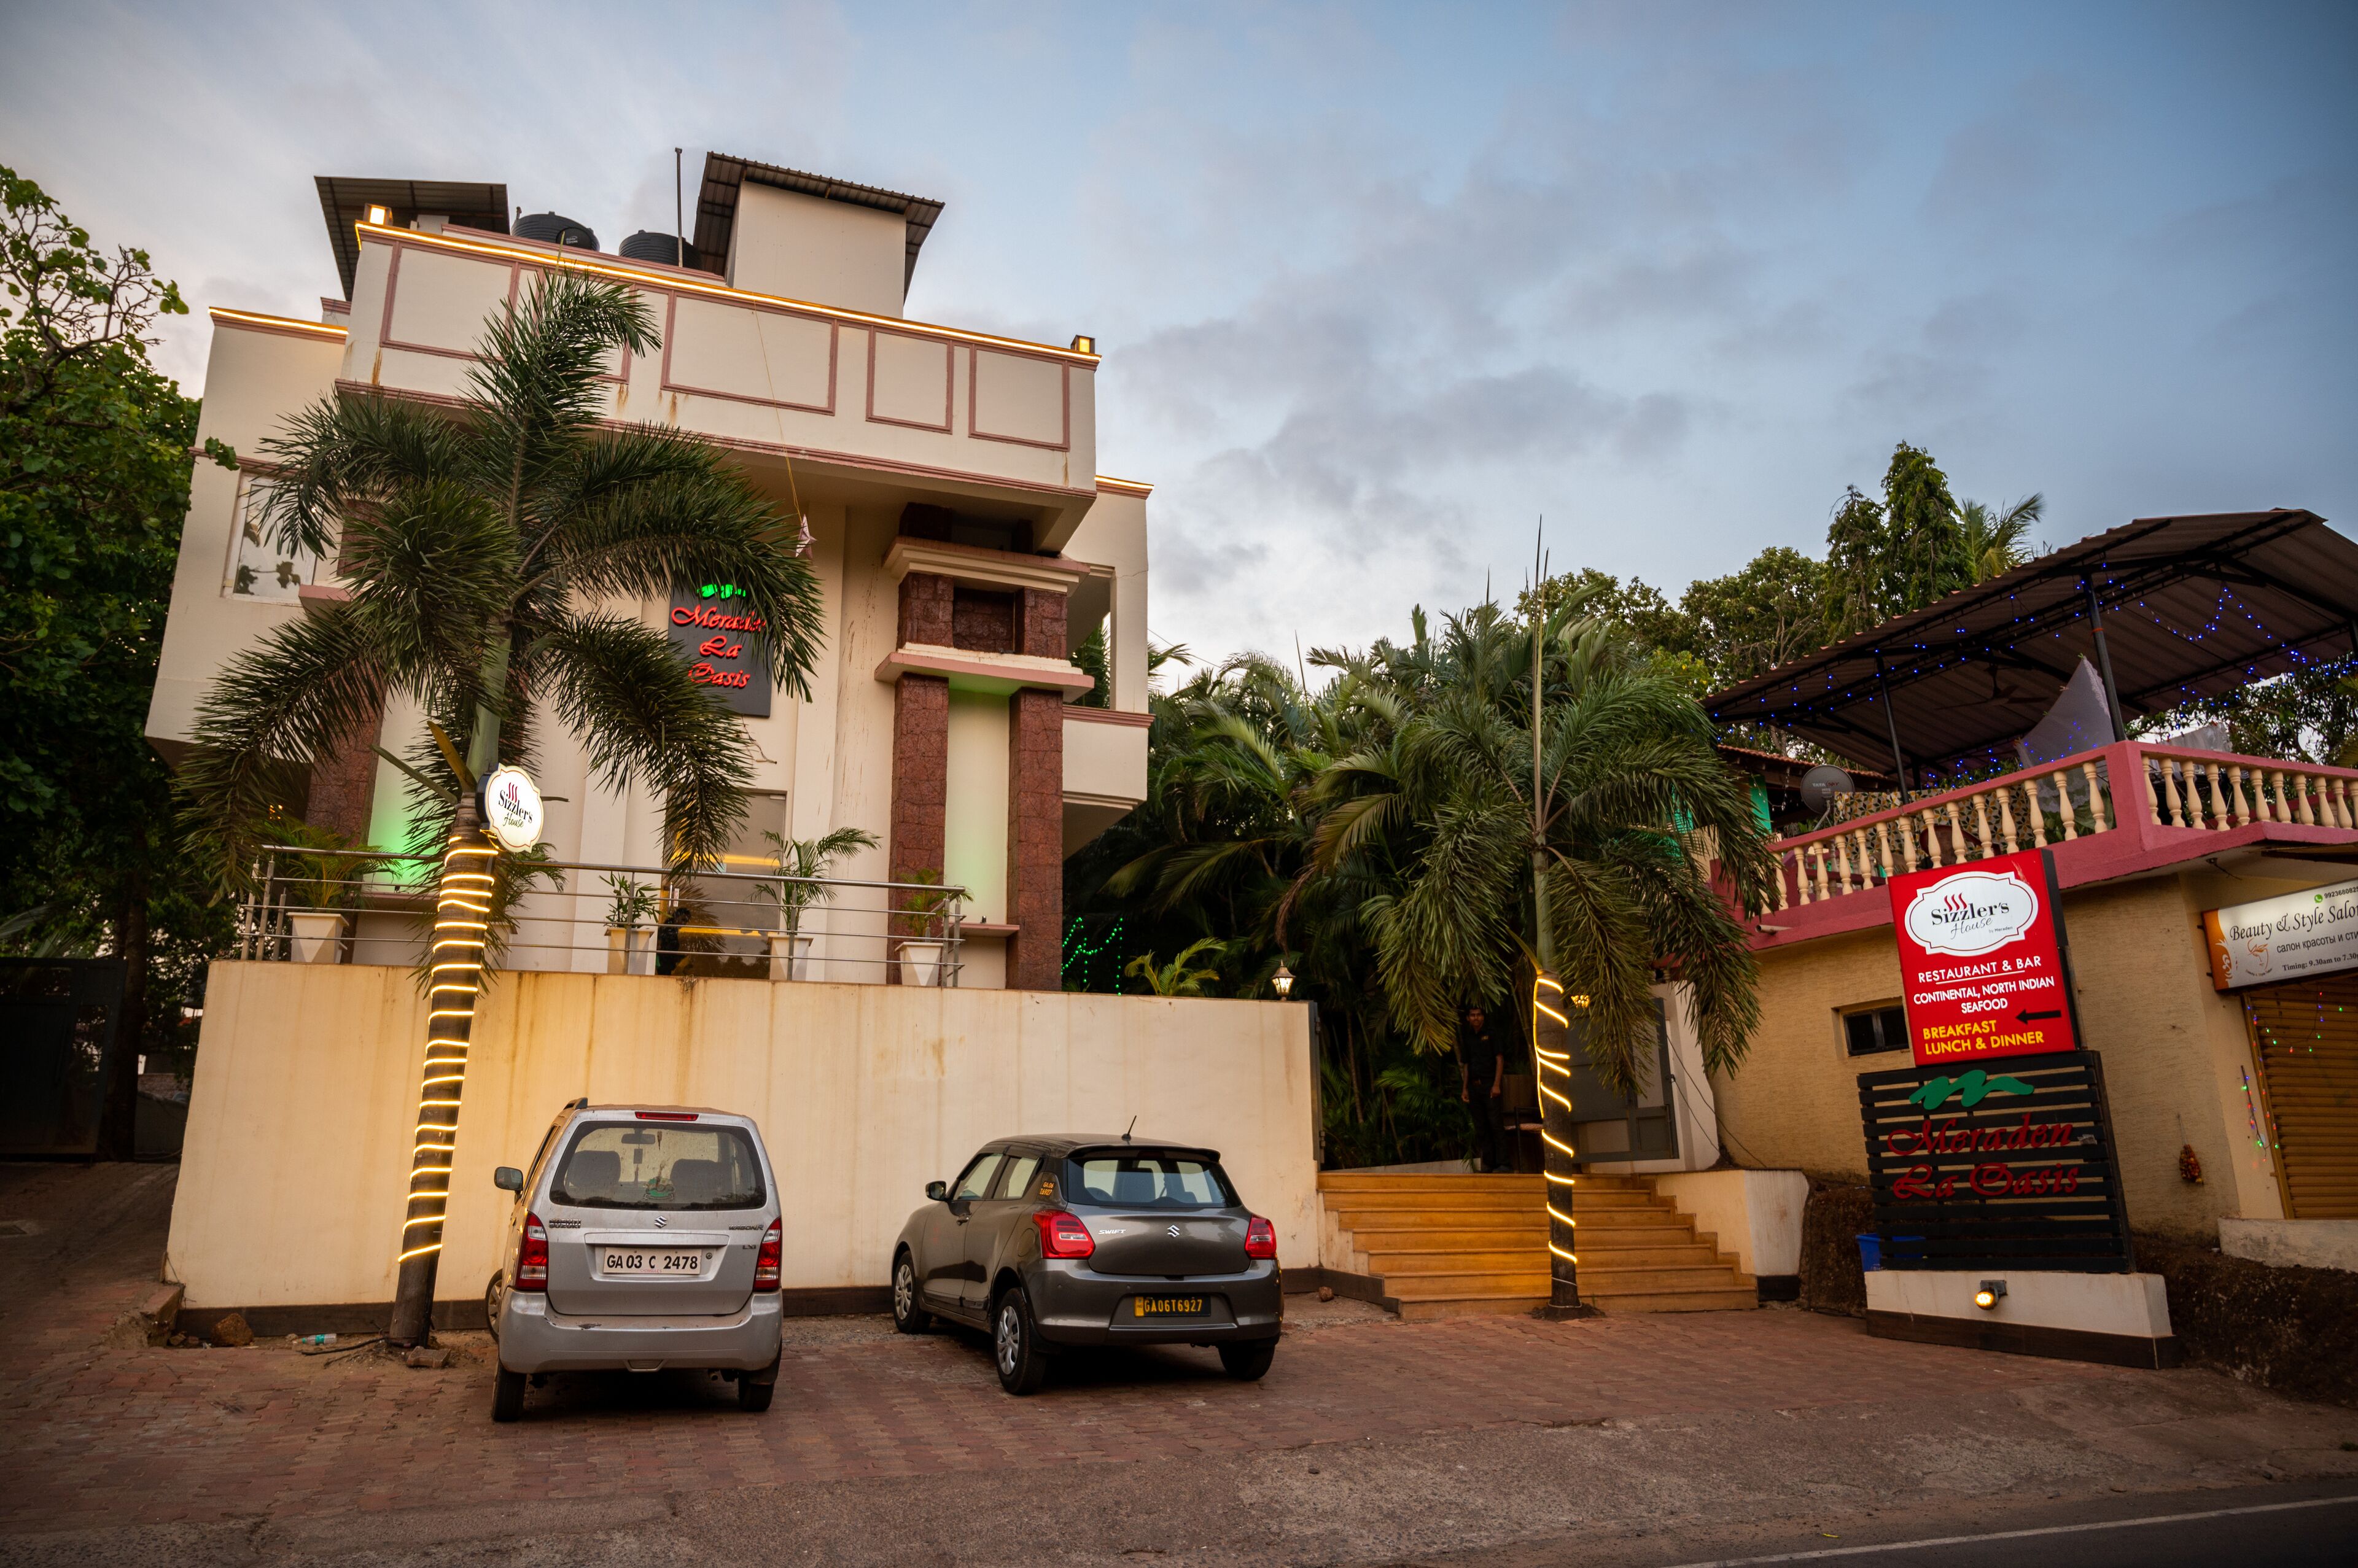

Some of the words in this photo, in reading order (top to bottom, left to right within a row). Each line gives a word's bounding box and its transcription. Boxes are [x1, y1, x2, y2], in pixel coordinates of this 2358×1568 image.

[699, 635, 742, 658] La
[688, 662, 751, 688] Oasis
[498, 790, 532, 823] Sizzler's
[503, 812, 524, 828] House
[1931, 902, 2009, 925] Sizzler's
[2230, 922, 2272, 941] Beauty
[2276, 914, 2290, 932] &
[2293, 907, 2324, 932] Style
[1950, 917, 1993, 940] House
[2276, 942, 2301, 953] салон
[2302, 936, 2336, 950] красоты
[1918, 962, 1997, 983] RESTAURANT
[2002, 960, 2012, 971] &
[2016, 956, 2041, 969] BAR
[2282, 961, 2308, 971] Timing:
[2309, 957, 2333, 967] 9.30am
[1913, 987, 1980, 1004] CONTINENTAL,
[1982, 981, 2017, 996] NORTH
[2019, 976, 2055, 990] INDIAN
[1961, 998, 2008, 1014] SEAFOOD
[1923, 1020, 1997, 1040] BREAKFAST
[1925, 1039, 1971, 1055] LUNCH
[1975, 1038, 1986, 1049] &
[1990, 1031, 2044, 1048] DINNER
[1888, 1112, 2073, 1155] Meraden
[1893, 1164, 1959, 1198] La
[1969, 1162, 2079, 1196] Oasis
[607, 1254, 623, 1268] GA
[626, 1255, 642, 1269] 03
[649, 1256, 656, 1269] C
[663, 1256, 698, 1270] 2478
[1144, 1299, 1202, 1312] GA06T6927
